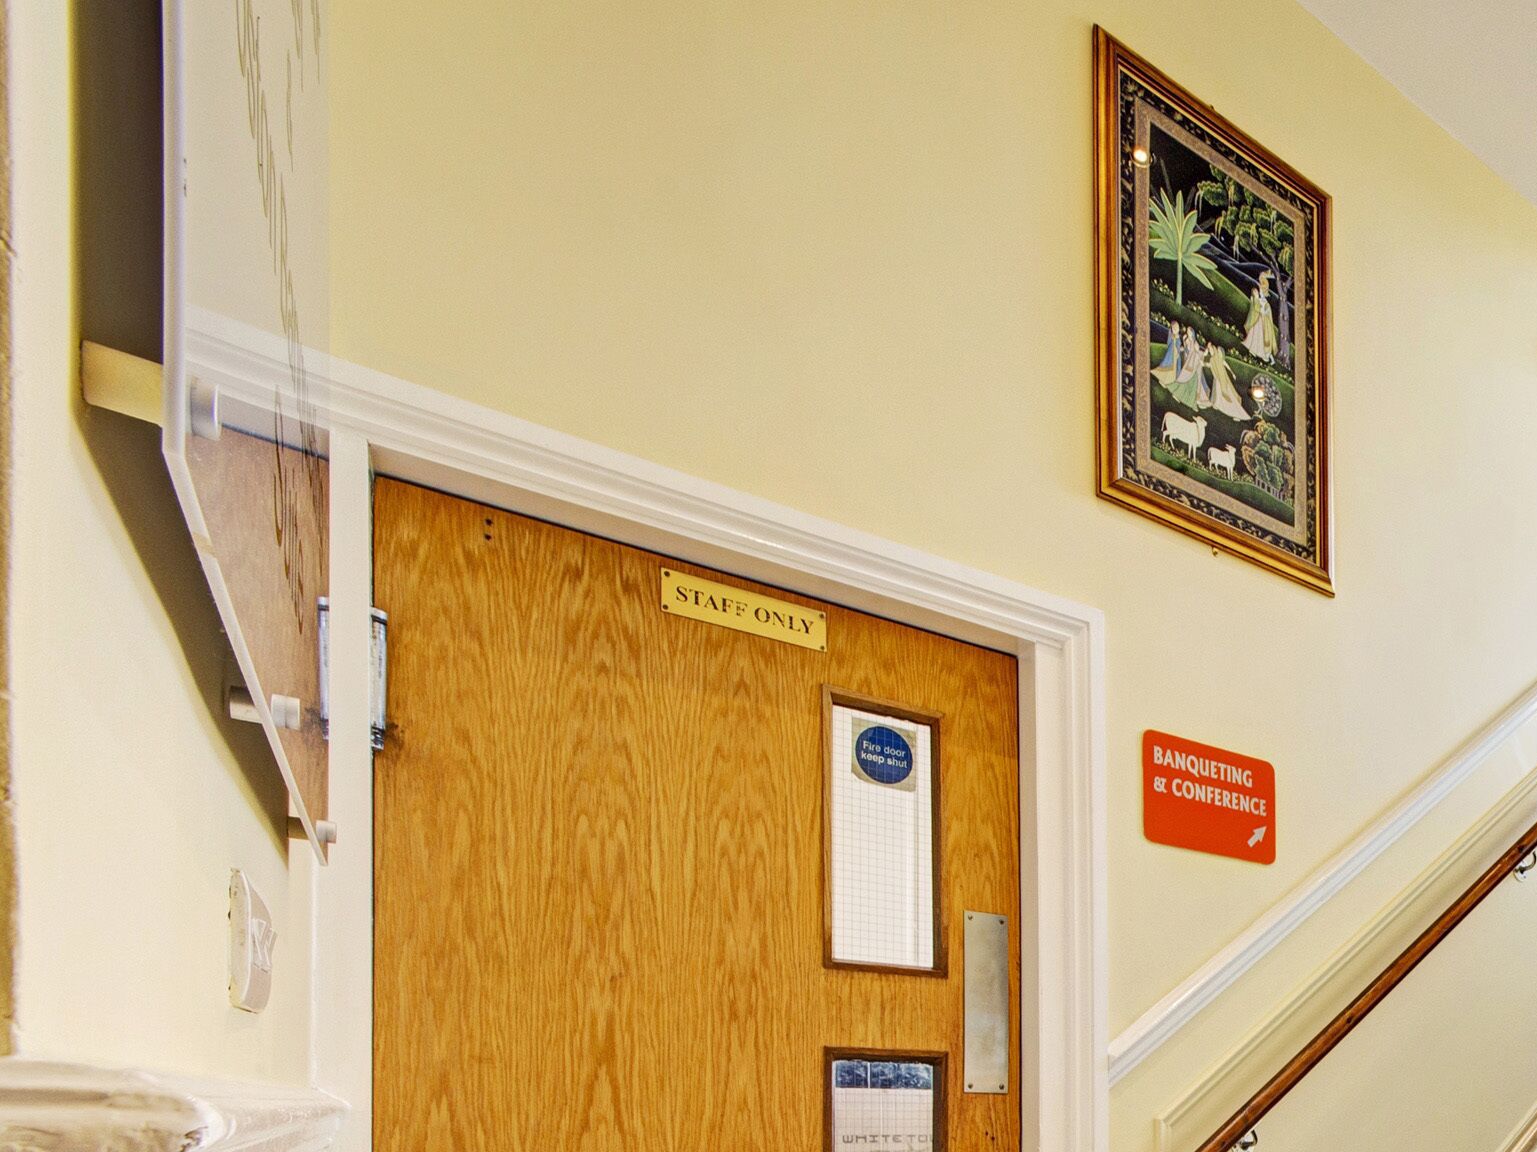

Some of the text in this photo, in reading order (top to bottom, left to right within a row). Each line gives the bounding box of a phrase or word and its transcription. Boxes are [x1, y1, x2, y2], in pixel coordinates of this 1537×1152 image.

[273, 384, 304, 636] Suite
[675, 585, 814, 634] STAFF ONLY
[861, 751, 908, 768] keep shut
[862, 740, 906, 757] Fire door
[1153, 745, 1253, 788] BANQUETING
[1153, 776, 1267, 817] & CONFERENCE
[842, 1134, 902, 1144] WHITE
